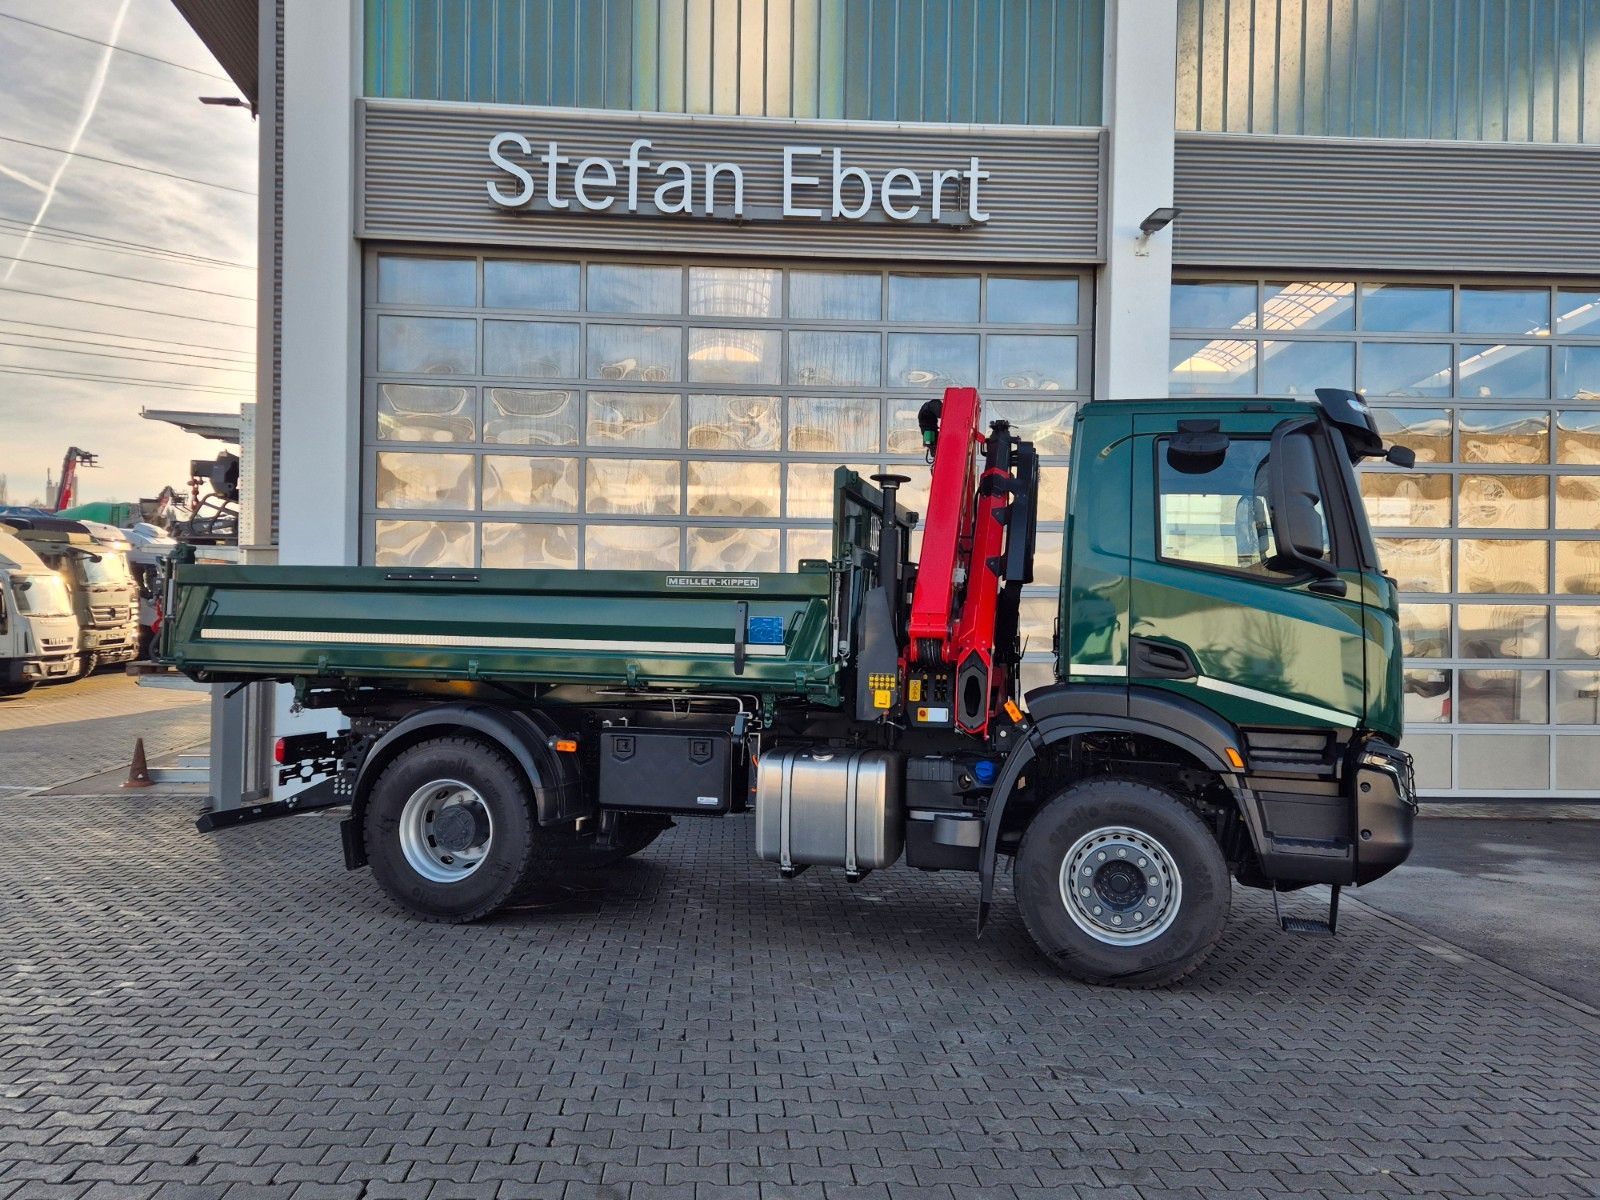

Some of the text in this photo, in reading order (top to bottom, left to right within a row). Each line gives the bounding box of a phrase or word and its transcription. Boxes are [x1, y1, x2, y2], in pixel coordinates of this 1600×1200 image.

[486, 131, 990, 222] Stefan Ebert
[668, 577, 757, 587] MEILLER-KIPPER
